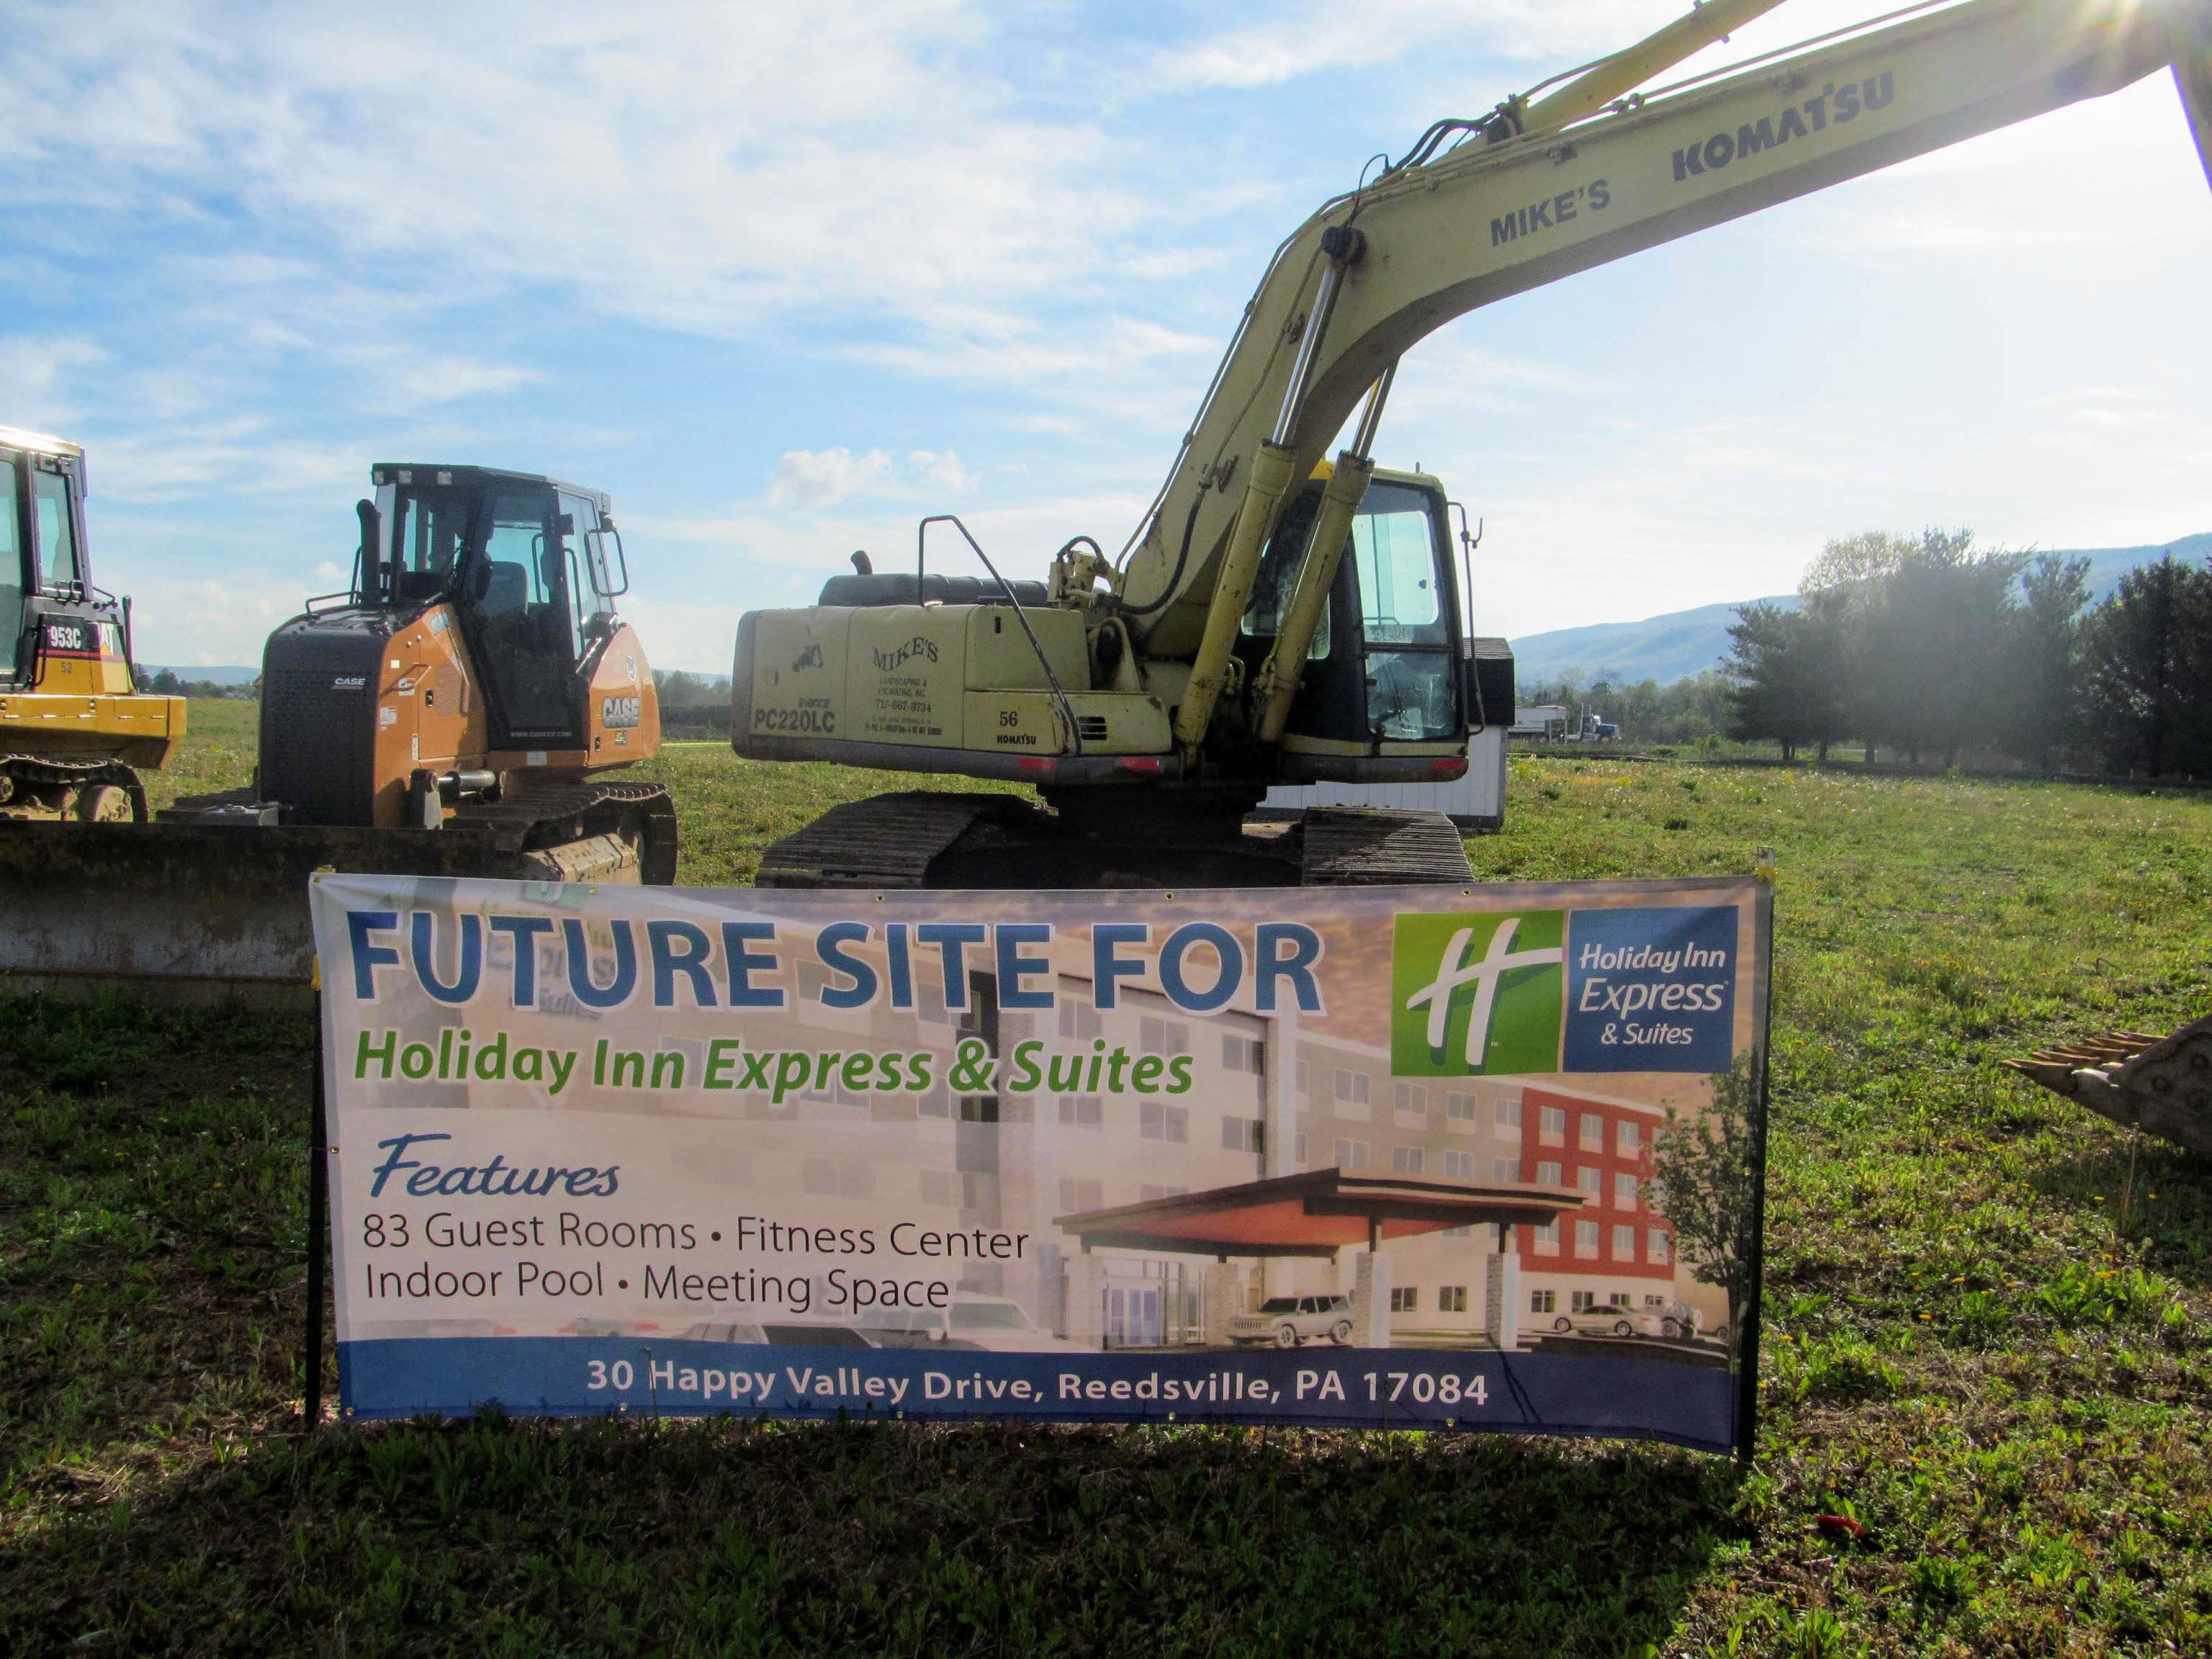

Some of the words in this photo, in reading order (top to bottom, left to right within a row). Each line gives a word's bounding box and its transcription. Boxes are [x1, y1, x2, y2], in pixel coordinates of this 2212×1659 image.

[1672, 70, 1895, 183] KOMATSU
[1490, 179, 1611, 248] MIKE'S
[50, 626, 81, 649] 953C
[873, 637, 938, 671] MIKE'S
[602, 696, 639, 729] CASE
[754, 708, 835, 732] PC220LC
[999, 711, 1018, 727] 56
[997, 733, 1037, 745] KOMATSU
[346, 911, 785, 1008] FUTURE
[815, 922, 1055, 1009] SITE
[1092, 922, 1322, 1012] FOR
[1580, 944, 1681, 973] Holiday
[1683, 942, 1726, 968] Inn
[1579, 977, 1724, 1020] Express
[1601, 1022, 1618, 1044] &
[1623, 1023, 1694, 1044] Suites
[355, 1030, 576, 1096] Holiday
[594, 1039, 685, 1089] Inn
[703, 1039, 932, 1105] Express
[949, 1039, 992, 1092] &
[1009, 1039, 1193, 1094] Suites
[371, 1133, 621, 1198] Features
[364, 1213, 410, 1247] 83
[426, 1212, 544, 1247] Guest
[559, 1213, 696, 1250] Rooms
[738, 1216, 876, 1254] Fitness
[890, 1223, 1029, 1258] Center
[367, 1262, 502, 1298] Indoor
[518, 1262, 603, 1296] Pool
[644, 1264, 811, 1313] Meeting
[828, 1269, 949, 1314] Space
[587, 1359, 634, 1390] 30
[649, 1360, 775, 1401] Happy
[786, 1367, 909, 1404] Valley
[922, 1372, 1043, 1403] Drive,
[1058, 1372, 1280, 1403] Reedsville,
[1296, 1370, 1346, 1401] PA
[1363, 1372, 1488, 1406] 17084
